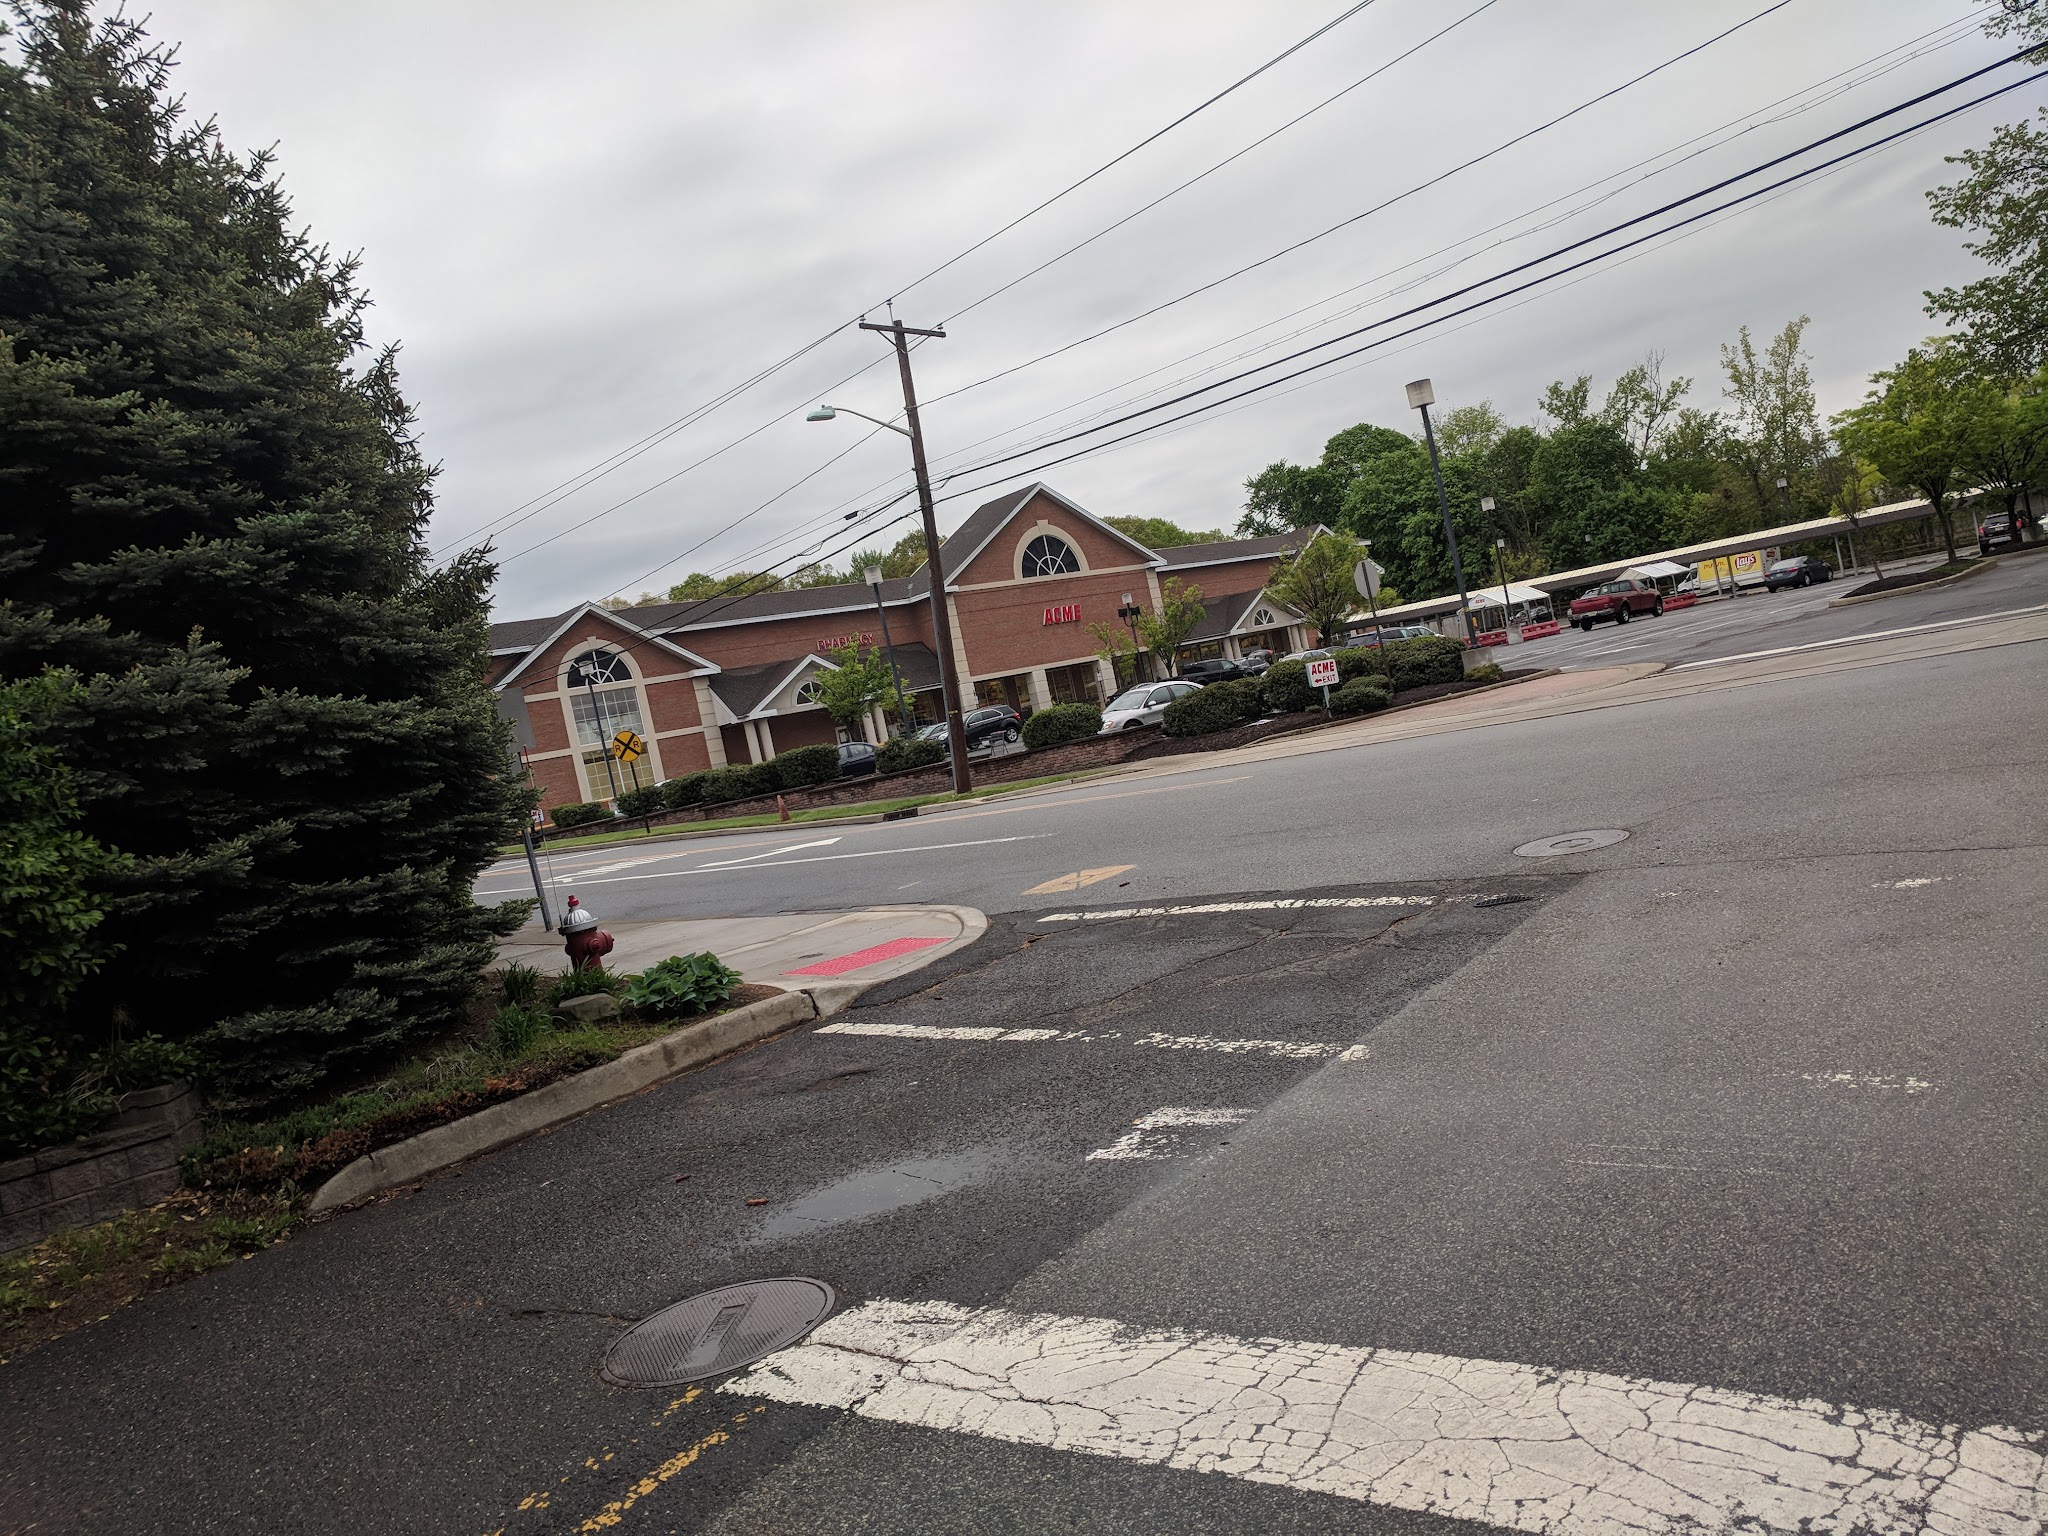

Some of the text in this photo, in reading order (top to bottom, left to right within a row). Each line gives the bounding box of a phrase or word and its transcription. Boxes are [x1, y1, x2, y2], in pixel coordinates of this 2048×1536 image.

[1736, 553, 1755, 568] Lay's
[1043, 605, 1082, 626] ACME
[1311, 661, 1335, 676] ACME
[1322, 674, 1336, 684] EXIT
[615, 740, 639, 752] R R
